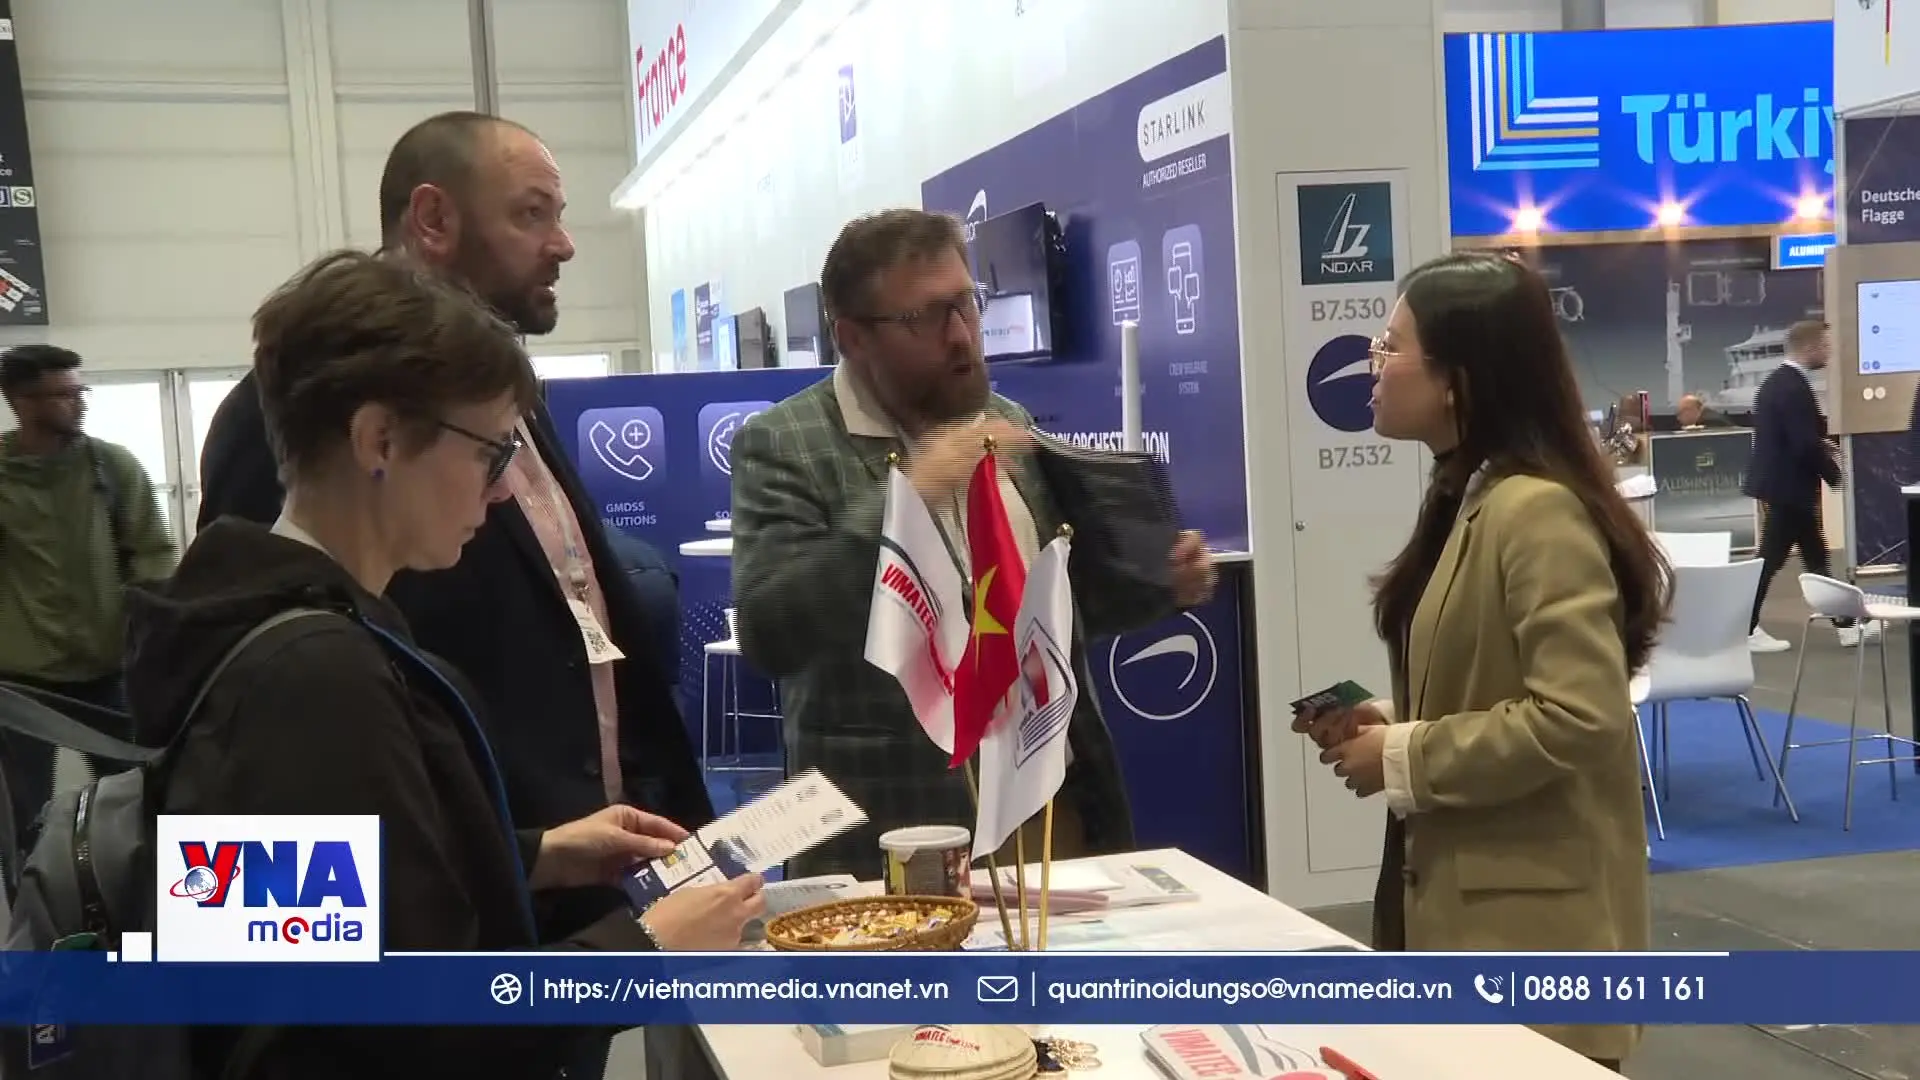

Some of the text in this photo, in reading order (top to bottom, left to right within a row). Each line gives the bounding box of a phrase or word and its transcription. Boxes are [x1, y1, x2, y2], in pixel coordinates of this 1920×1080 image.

[637, 23, 686, 146] France
[1143, 99, 1206, 147] STARLINK
[1143, 153, 1207, 188] AUTHORIZED RESELLER
[1861, 188, 1920, 203] Deutsche
[1862, 208, 1905, 224] Flagge
[1321, 261, 1374, 274] NDAR
[1311, 297, 1386, 322] B7.530
[1319, 444, 1394, 469] B7.532
[605, 501, 645, 513] GMDSS
[601, 515, 657, 527] OLUTIONS
